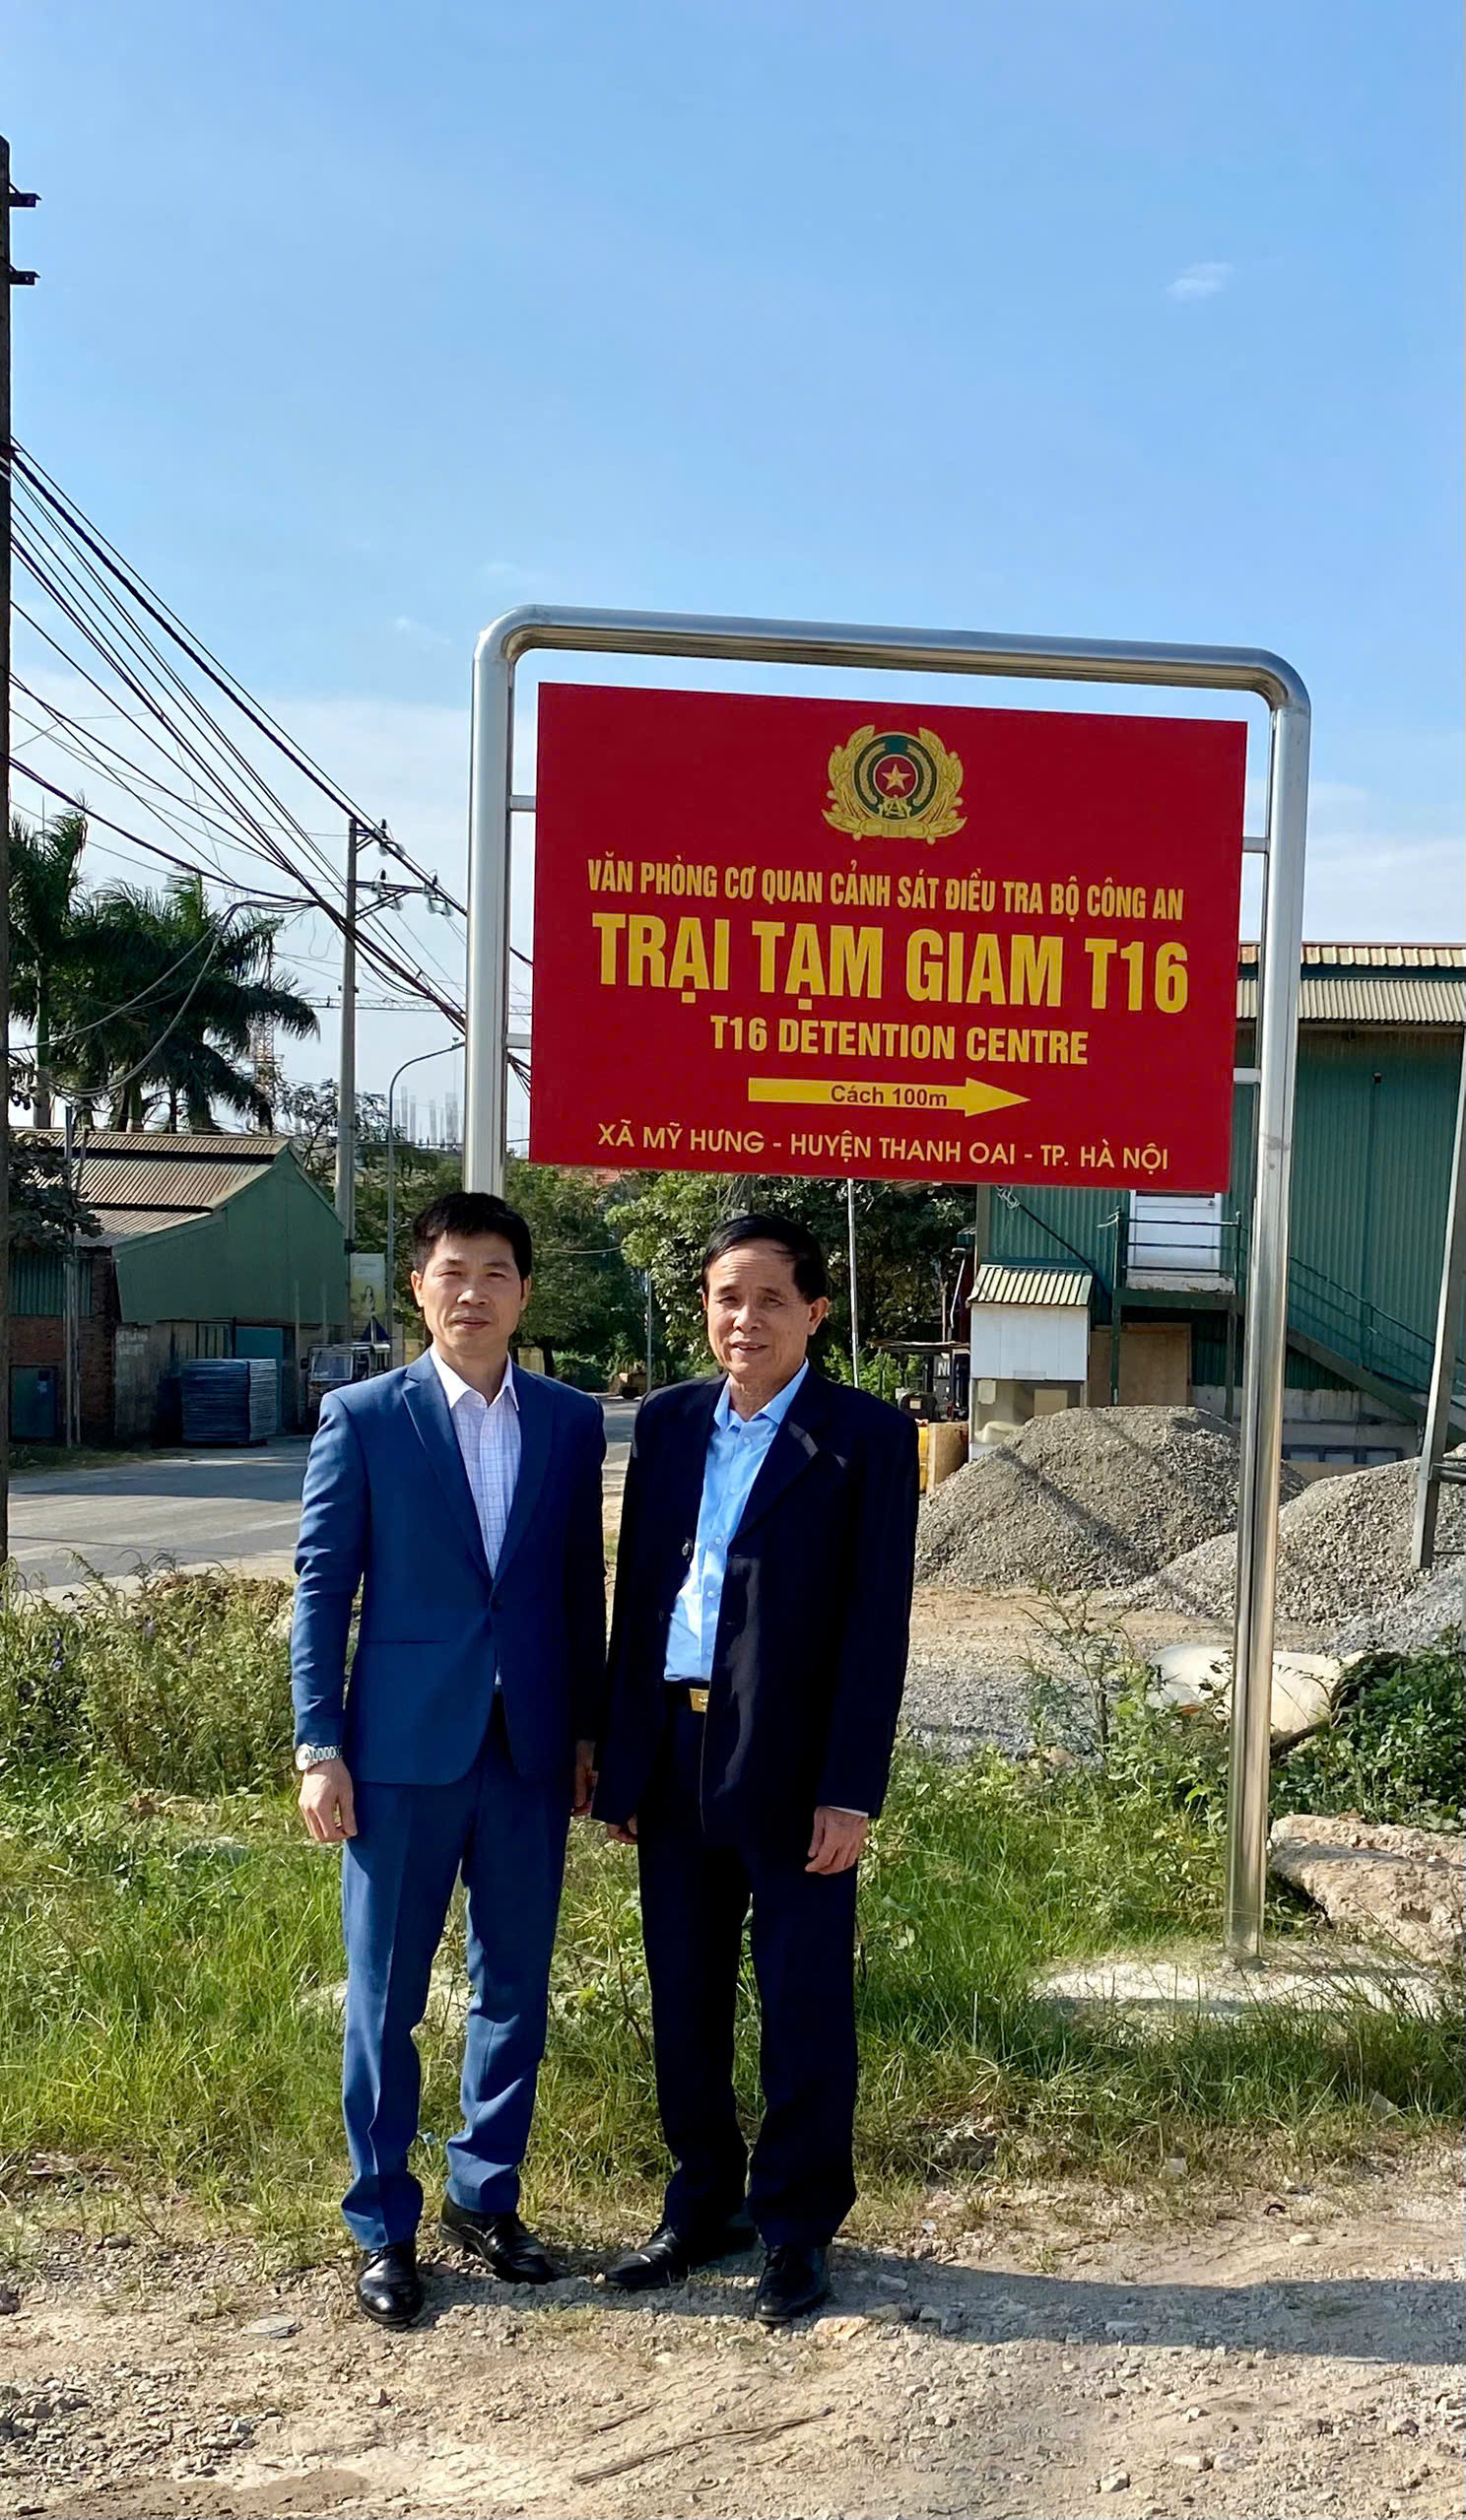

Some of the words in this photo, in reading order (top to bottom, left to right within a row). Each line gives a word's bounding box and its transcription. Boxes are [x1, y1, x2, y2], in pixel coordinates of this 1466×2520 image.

[588, 851, 633, 893] VĂN
[640, 855, 718, 897] PHÒNG
[725, 866, 757, 899] CƠ
[762, 869, 823, 904] QUAN
[831, 859, 891, 907] CẢNH
[898, 869, 939, 909] SÁT
[946, 868, 996, 912] ĐIỀU
[1003, 882, 1043, 914] TRA
[1051, 876, 1080, 922] BỘ
[1088, 877, 1147, 919] CÔNG
[1153, 889, 1184, 920] AN
[592, 913, 730, 1003] TRẠI
[752, 921, 883, 1010] TẠM
[906, 929, 1064, 1008] GIAM
[1085, 938, 1188, 1014] T16
[710, 1016, 767, 1051] T16
[779, 1019, 956, 1060] DETENTION
[966, 1028, 1089, 1065] CENTRE
[832, 1085, 884, 1103] Cách
[893, 1087, 947, 1106] 100m
[598, 1119, 635, 1148] XÃ
[643, 1122, 683, 1150] MỸ
[691, 1129, 765, 1154] HƯNG
[791, 1130, 872, 1163] HUYỆN
[879, 1138, 962, 1162] THANH
[969, 1142, 1016, 1165] OAI
[1040, 1145, 1069, 1166] TP.
[1081, 1139, 1115, 1168] HÀ
[1123, 1143, 1168, 1174] NỘI
